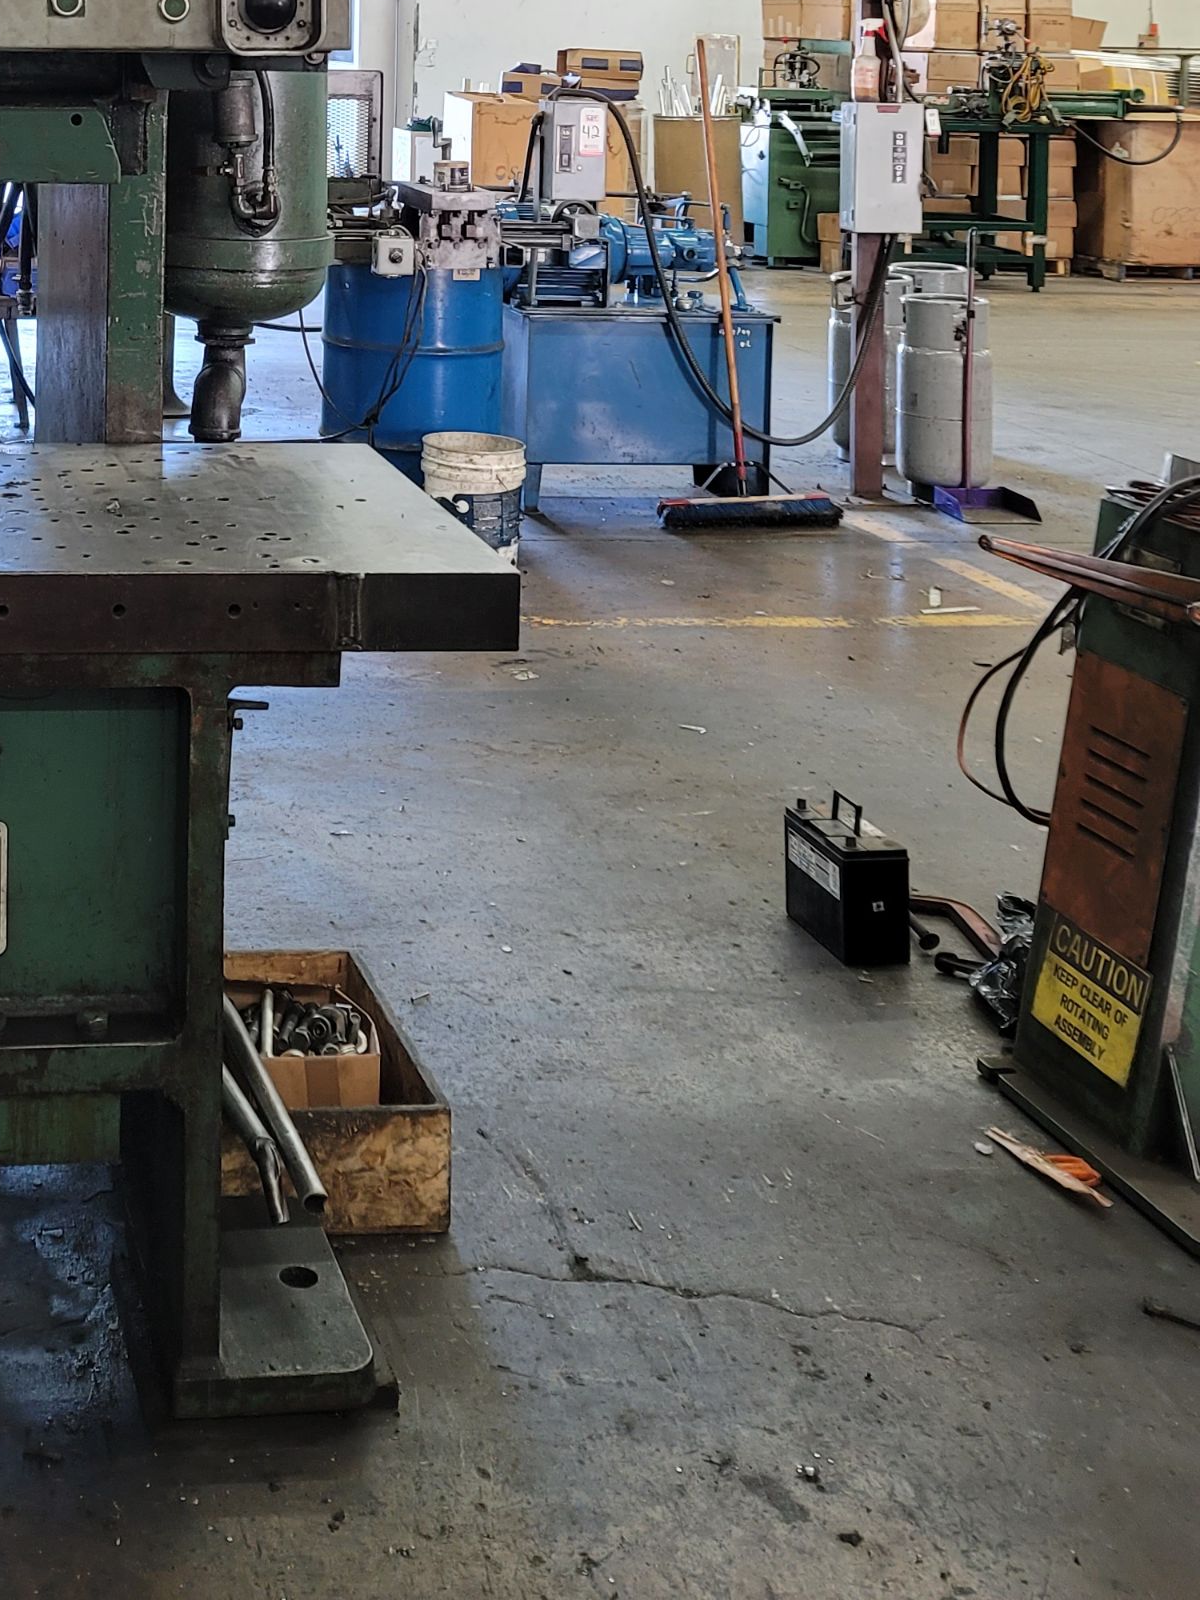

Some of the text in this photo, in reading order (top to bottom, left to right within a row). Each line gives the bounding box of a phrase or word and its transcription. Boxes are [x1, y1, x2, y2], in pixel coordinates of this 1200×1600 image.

[582, 124, 600, 139] 42
[1056, 925, 1144, 1008] CAUTION
[1053, 963, 1128, 1027] KEEP CLEAR OF
[1060, 994, 1110, 1040] ROTATING
[1054, 1014, 1106, 1061] ASSEMBLY
